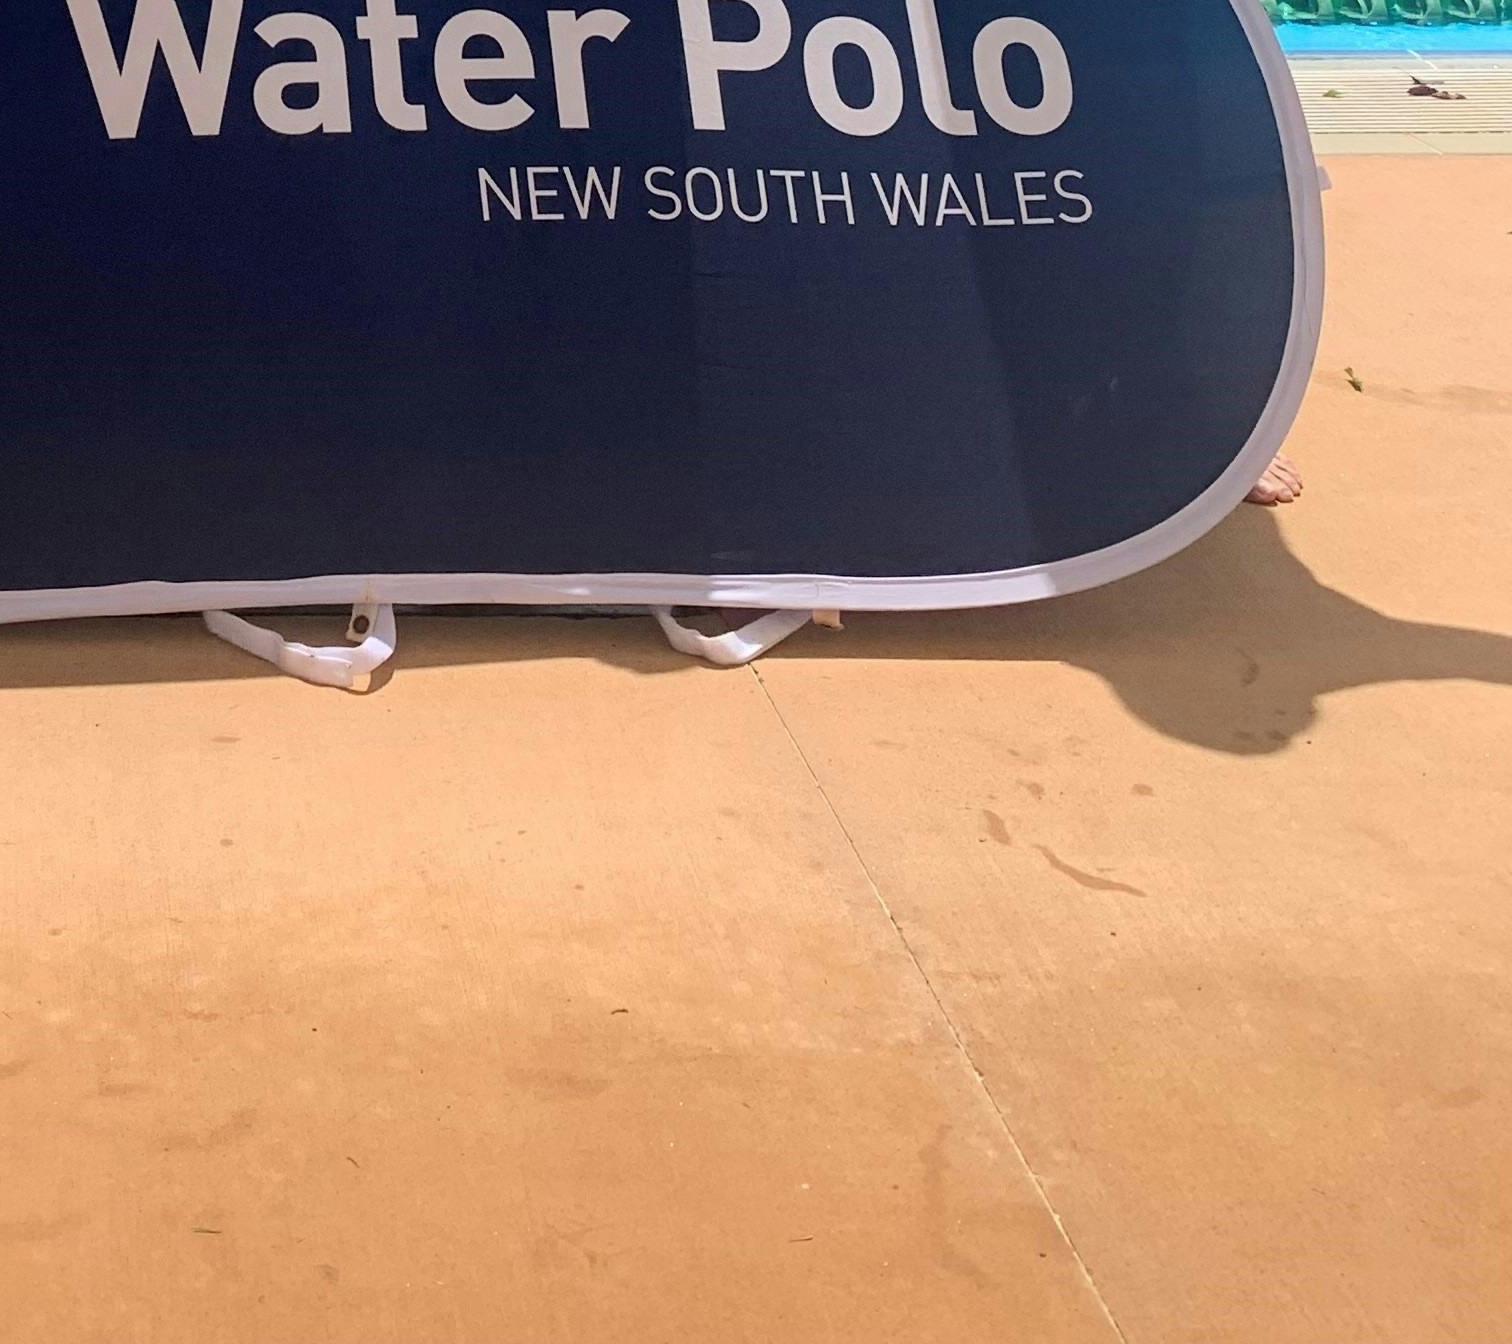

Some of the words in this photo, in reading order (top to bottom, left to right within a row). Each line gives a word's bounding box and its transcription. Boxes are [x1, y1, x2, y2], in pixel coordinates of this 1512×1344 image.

[479, 167, 620, 221] NEW
[645, 167, 854, 224] SOUTH
[871, 170, 1092, 226] WALES
